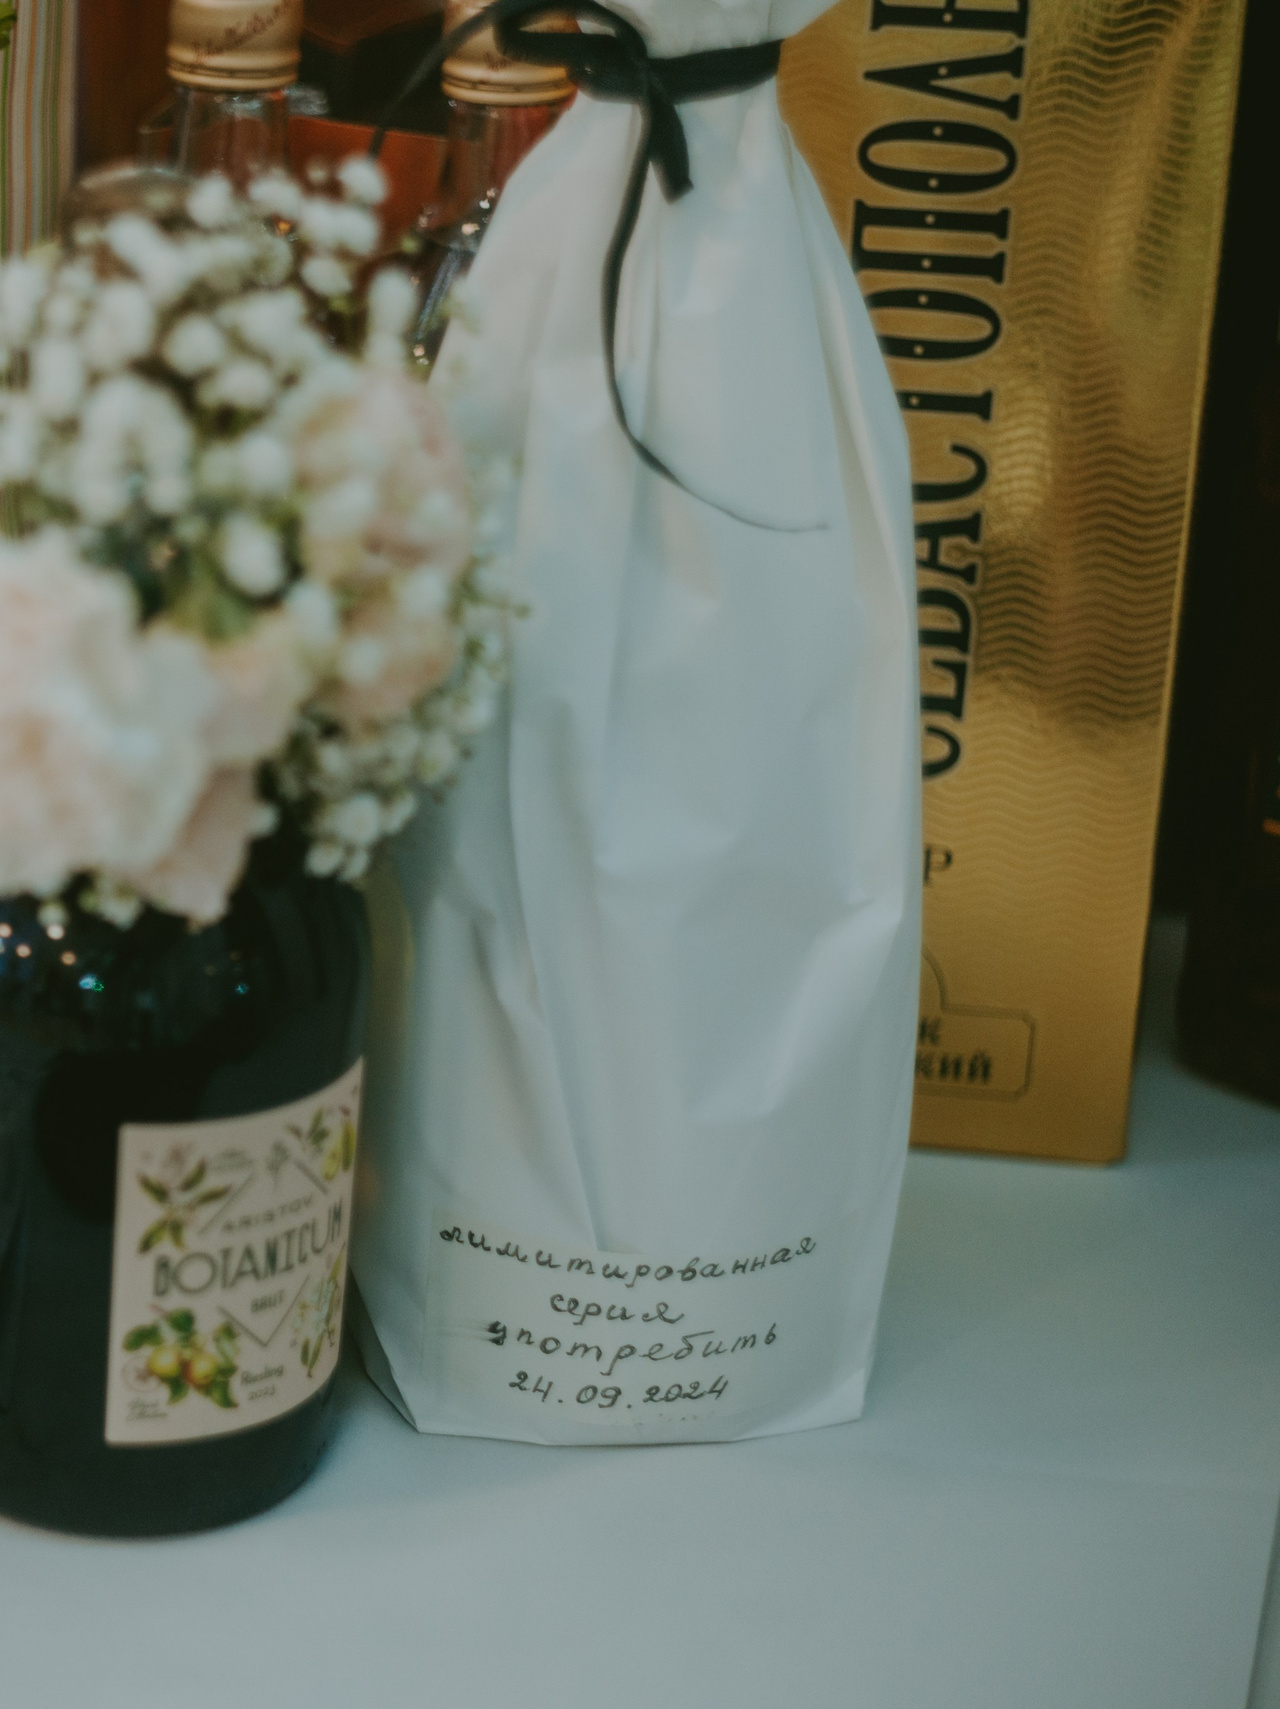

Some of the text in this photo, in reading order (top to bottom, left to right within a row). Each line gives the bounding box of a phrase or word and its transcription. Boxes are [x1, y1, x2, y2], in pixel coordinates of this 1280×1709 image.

[850, 0, 1029, 781] СТОПОЛ
[152, 1194, 343, 1297] BOTANICUM
[439, 1225, 817, 1288] лимитированная
[549, 1293, 685, 1326] серия
[487, 1321, 778, 1377] употребить
[508, 1370, 730, 1409] 24.09.2024
